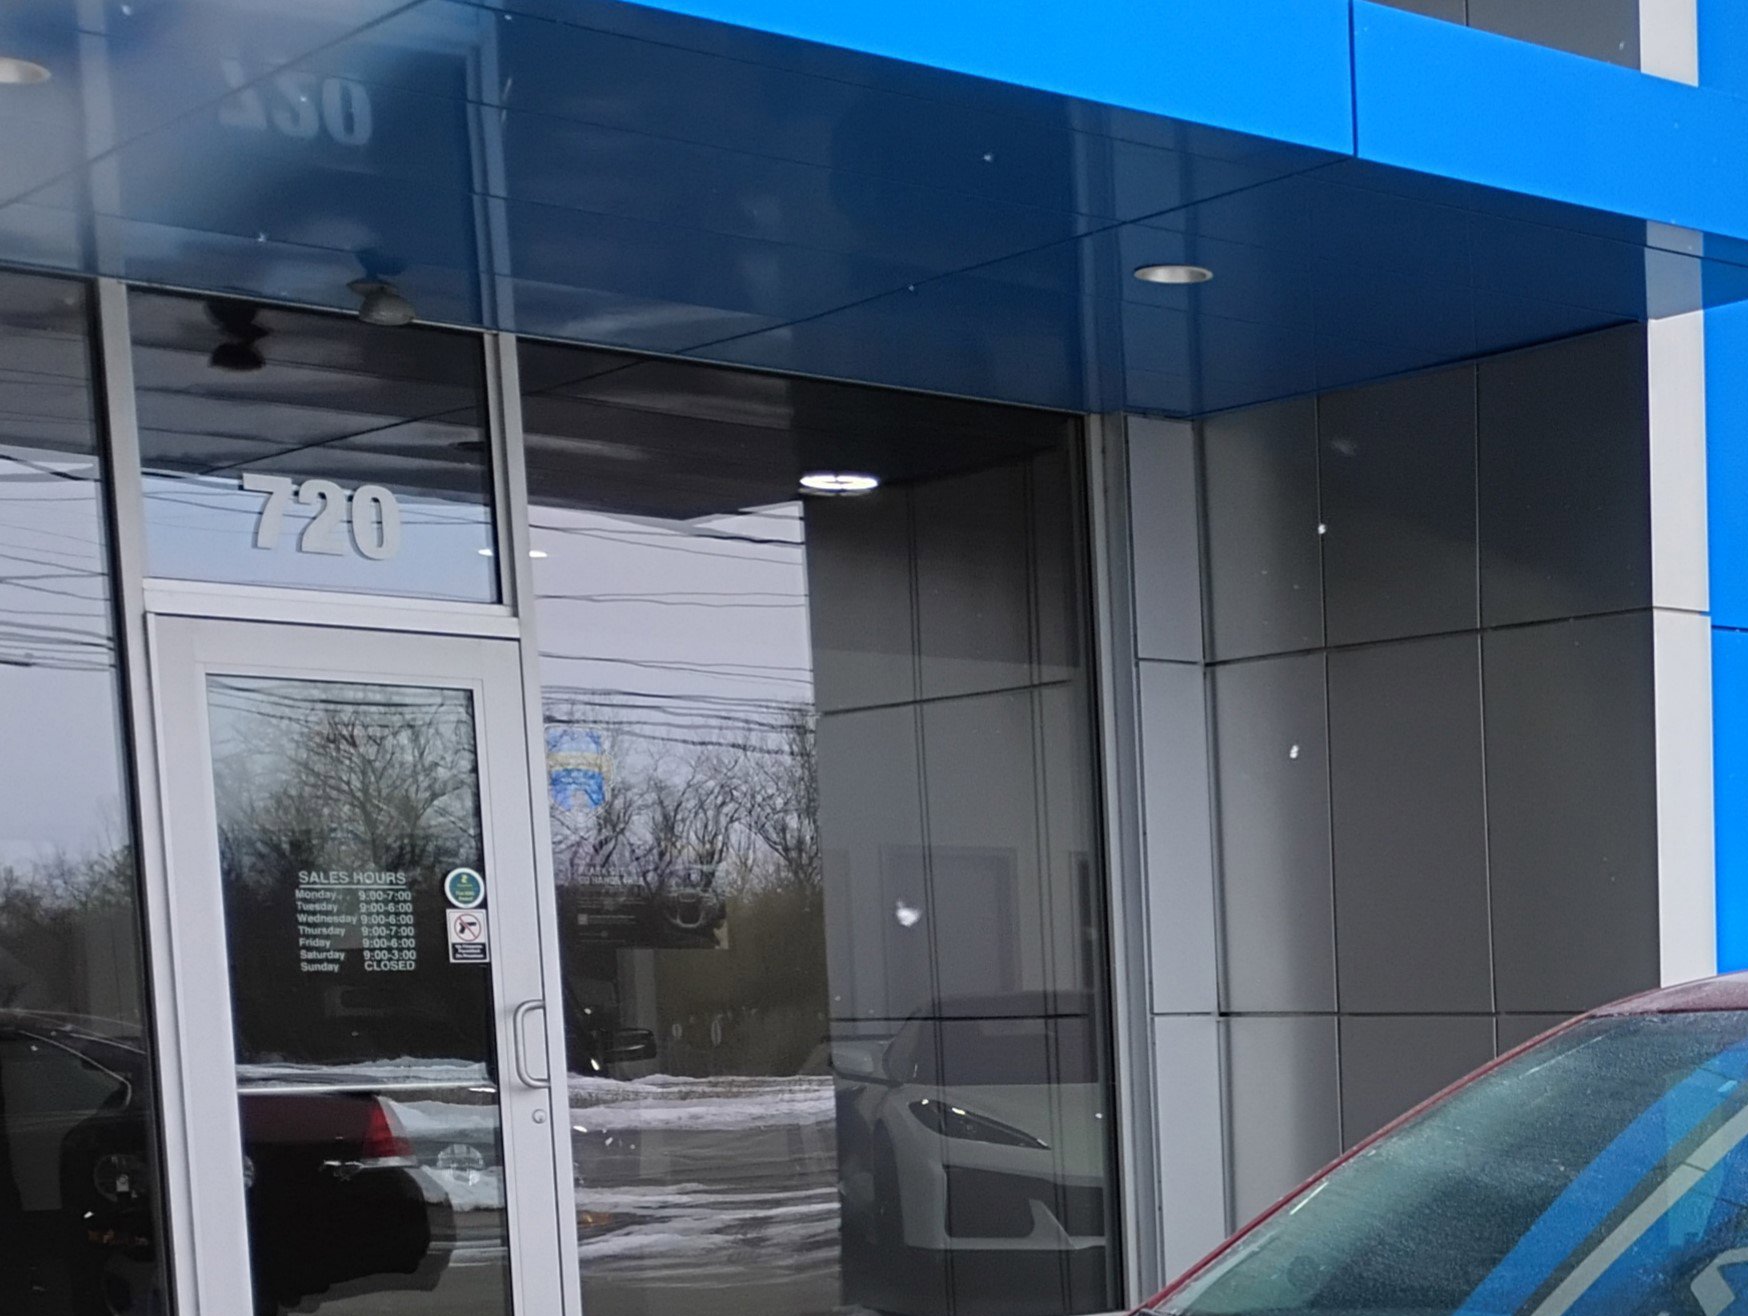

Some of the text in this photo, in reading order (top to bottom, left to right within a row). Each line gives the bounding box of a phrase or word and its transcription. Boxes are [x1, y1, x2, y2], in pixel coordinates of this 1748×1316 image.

[242, 473, 401, 562] 720
[298, 870, 407, 885] SALES HOURS
[295, 889, 412, 901] Monday 9:00-7:00
[296, 902, 413, 913] Tuesday 9:00-6:00
[296, 914, 414, 925] Wednesday 9:00-6:00
[298, 926, 415, 937] Thursday 9:00-7:00
[298, 938, 416, 949] Friday 9:00-6:00
[299, 950, 417, 961] Saturday 9:00-3:00
[300, 960, 416, 973] Sunday CLOSED
